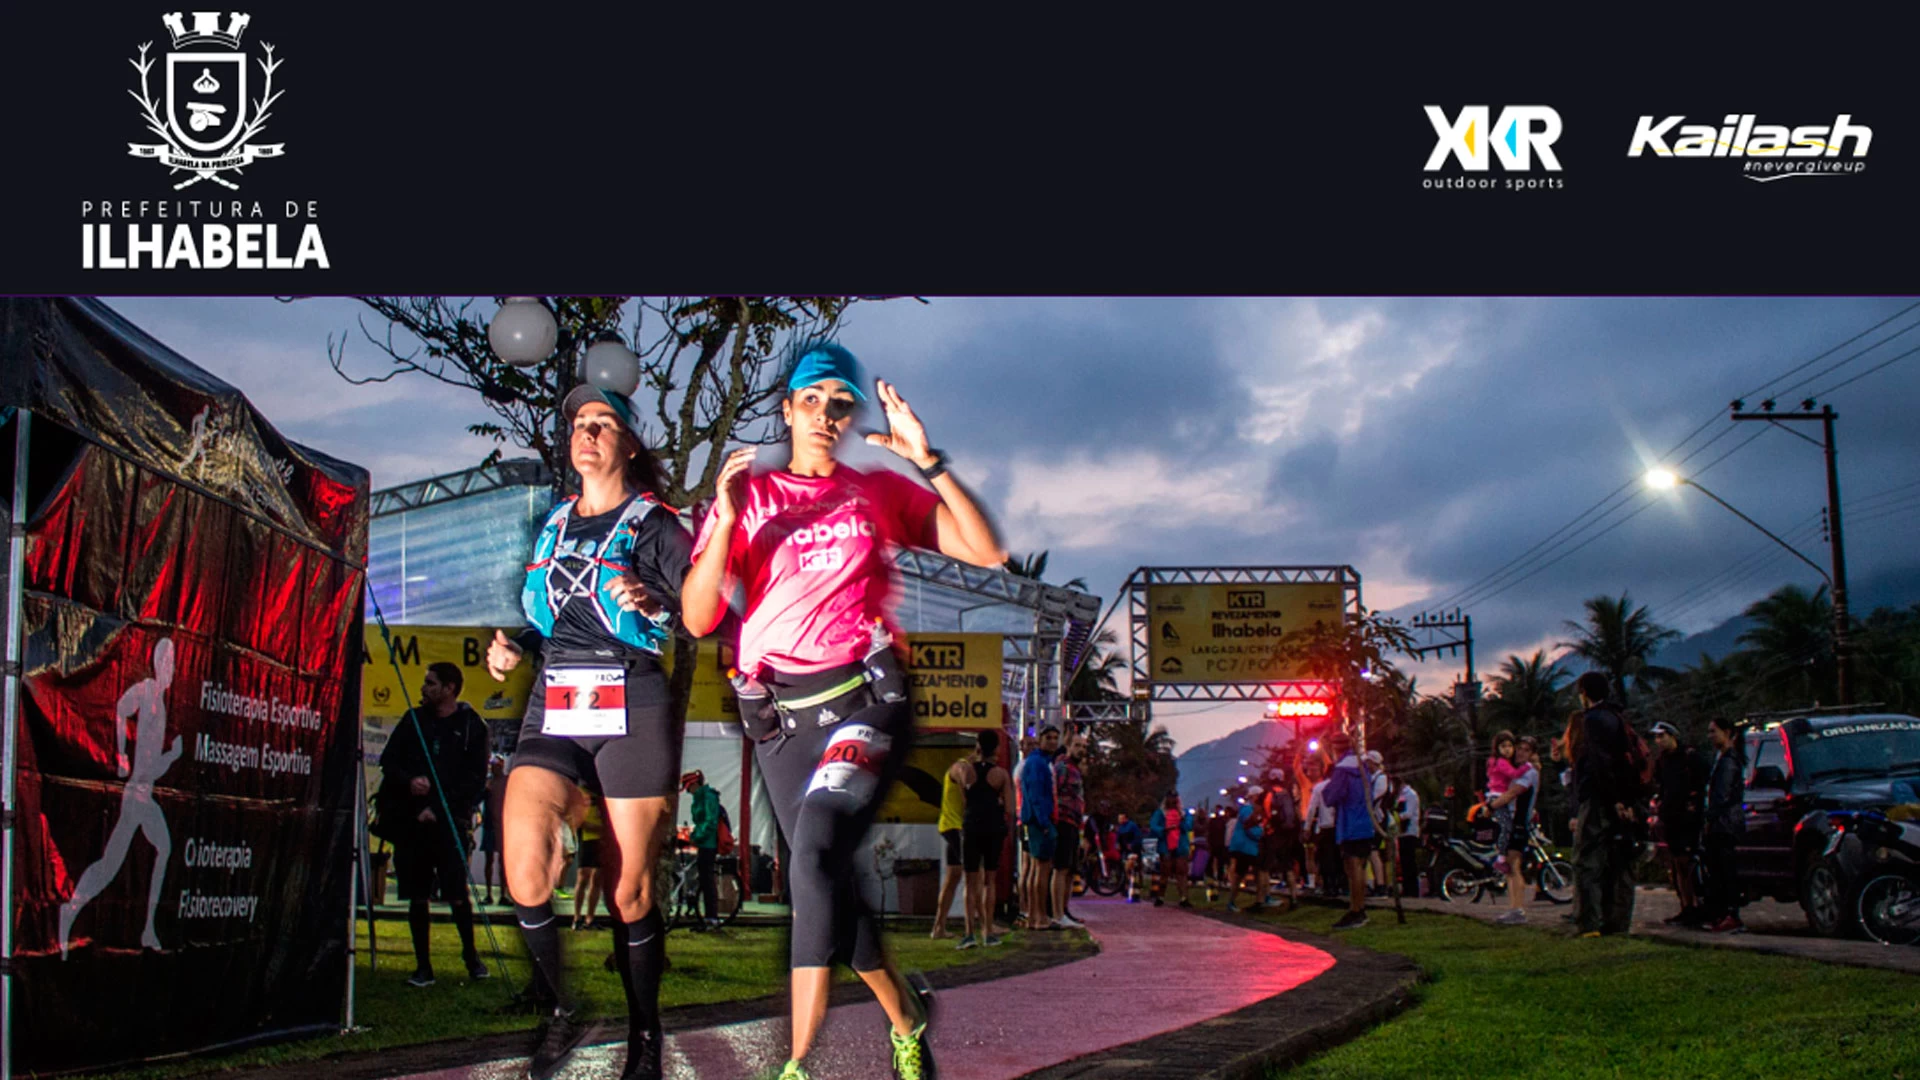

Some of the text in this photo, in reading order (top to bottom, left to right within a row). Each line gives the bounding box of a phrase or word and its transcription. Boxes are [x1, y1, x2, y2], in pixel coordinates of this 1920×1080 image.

[1230, 591, 1264, 608] KTR
[1212, 623, 1282, 638] Ilhabela
[911, 644, 962, 667] KTR
[200, 681, 269, 725] Fisioterapia
[270, 696, 321, 732] Esportiva
[195, 732, 312, 778] Massagem Esportiva
[178, 888, 258, 923] Fisiorecovery
